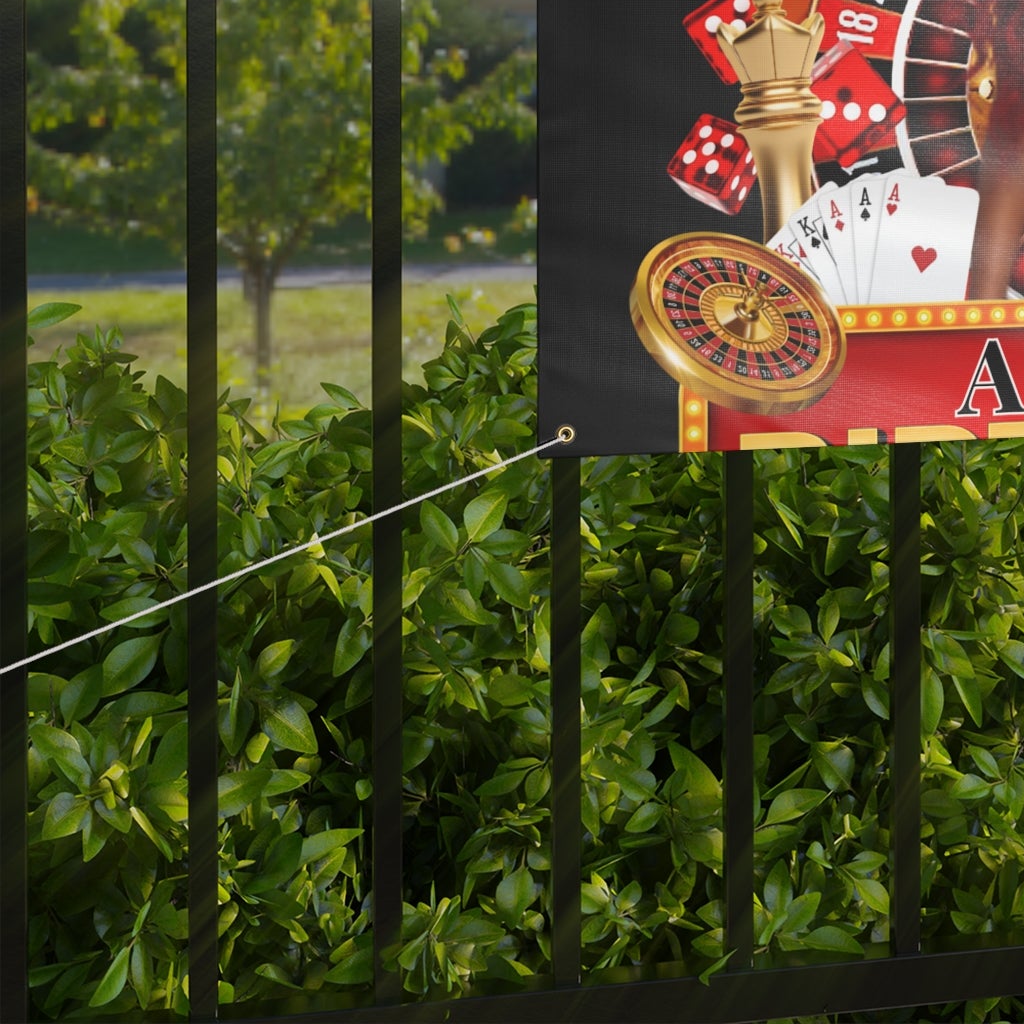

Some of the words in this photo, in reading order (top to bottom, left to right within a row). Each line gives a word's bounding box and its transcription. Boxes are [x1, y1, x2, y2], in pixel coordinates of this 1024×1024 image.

[836, 9, 879, 45] 18
[797, 216, 816, 237] K
[830, 199, 843, 219] A
[859, 186, 872, 206] A
[887, 182, 901, 202] A
